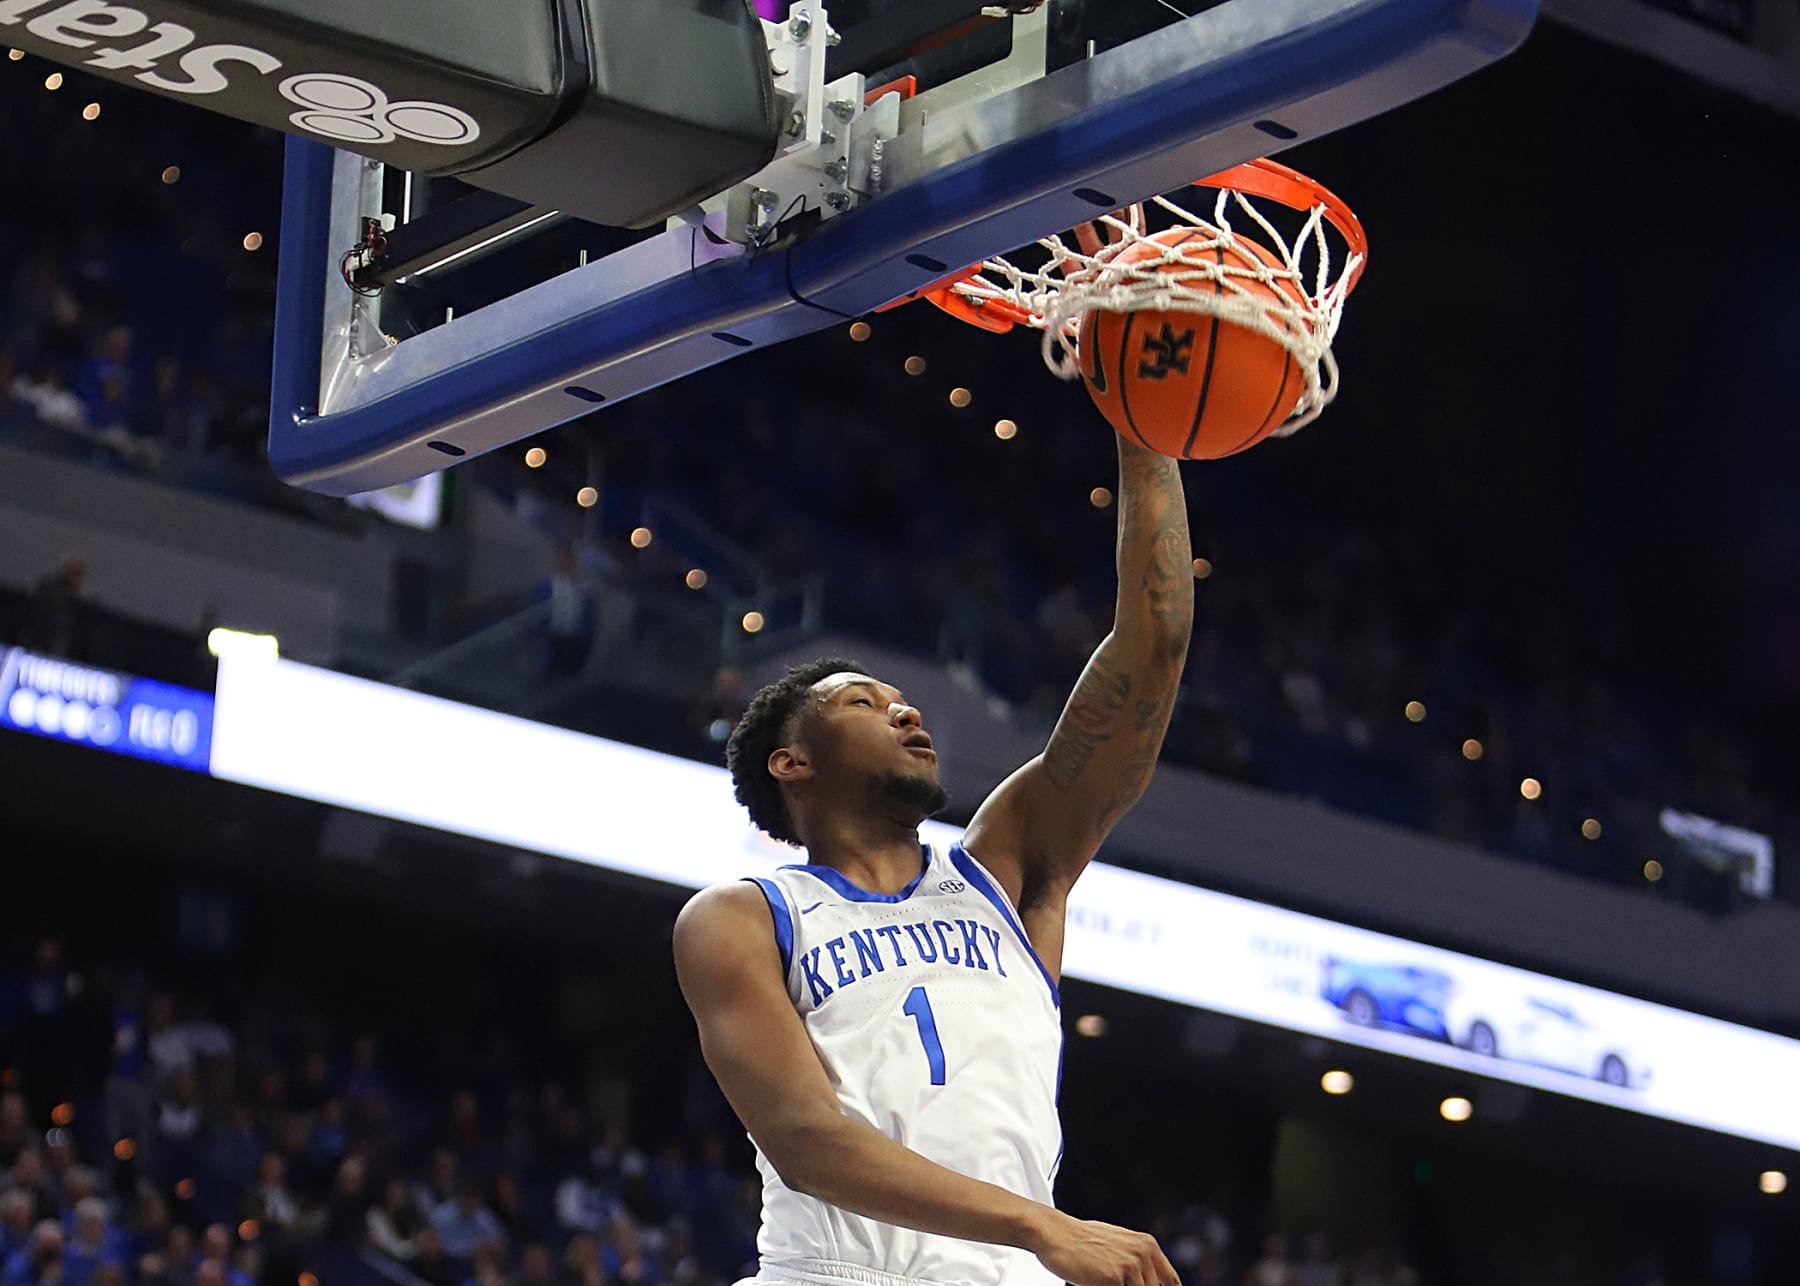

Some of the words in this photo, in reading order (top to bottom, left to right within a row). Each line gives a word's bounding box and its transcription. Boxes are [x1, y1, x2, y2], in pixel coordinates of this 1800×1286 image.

[938, 880, 966, 894] SEC
[800, 919, 1007, 1007] KENTUCKY
[902, 986, 946, 1085] 1
